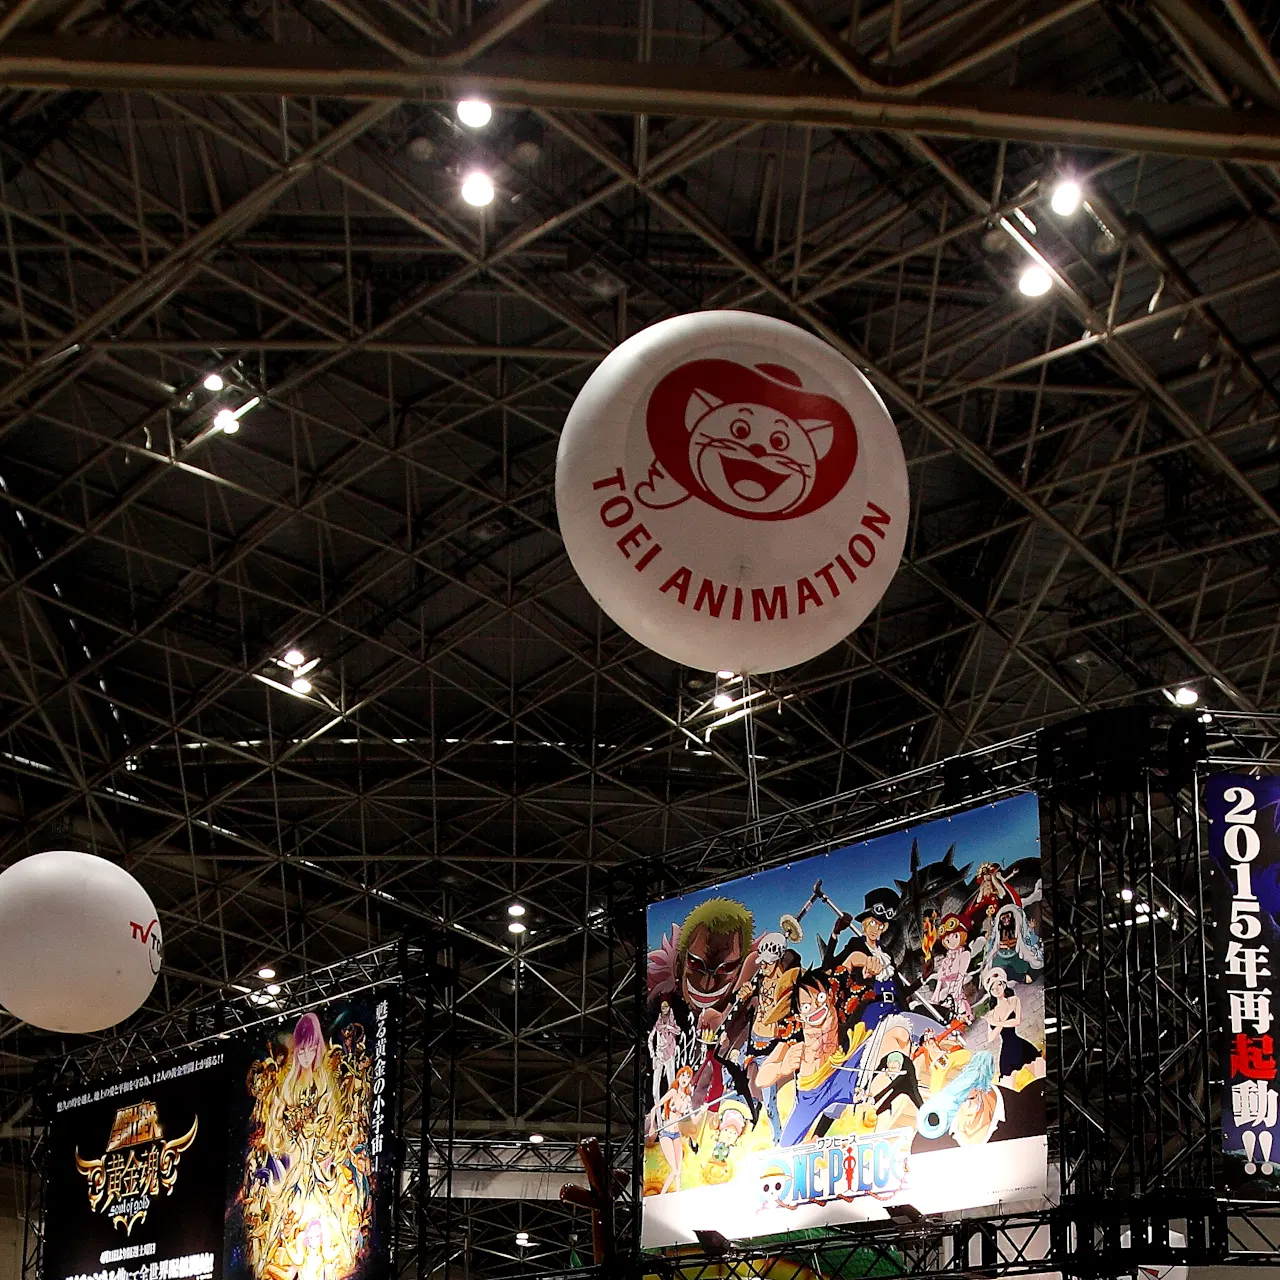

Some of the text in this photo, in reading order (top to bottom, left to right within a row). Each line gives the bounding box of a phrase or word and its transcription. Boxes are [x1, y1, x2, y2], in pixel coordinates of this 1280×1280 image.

[592, 467, 892, 622] TOEI ANIMATION
[130, 919, 158, 944] TV
[1222, 787, 1278, 1176] 2015年再起動!!
[816, 1135, 858, 1151] ワンピース
[100, 1143, 160, 1213] 黄金魂
[760, 1153, 824, 1202] ONE
